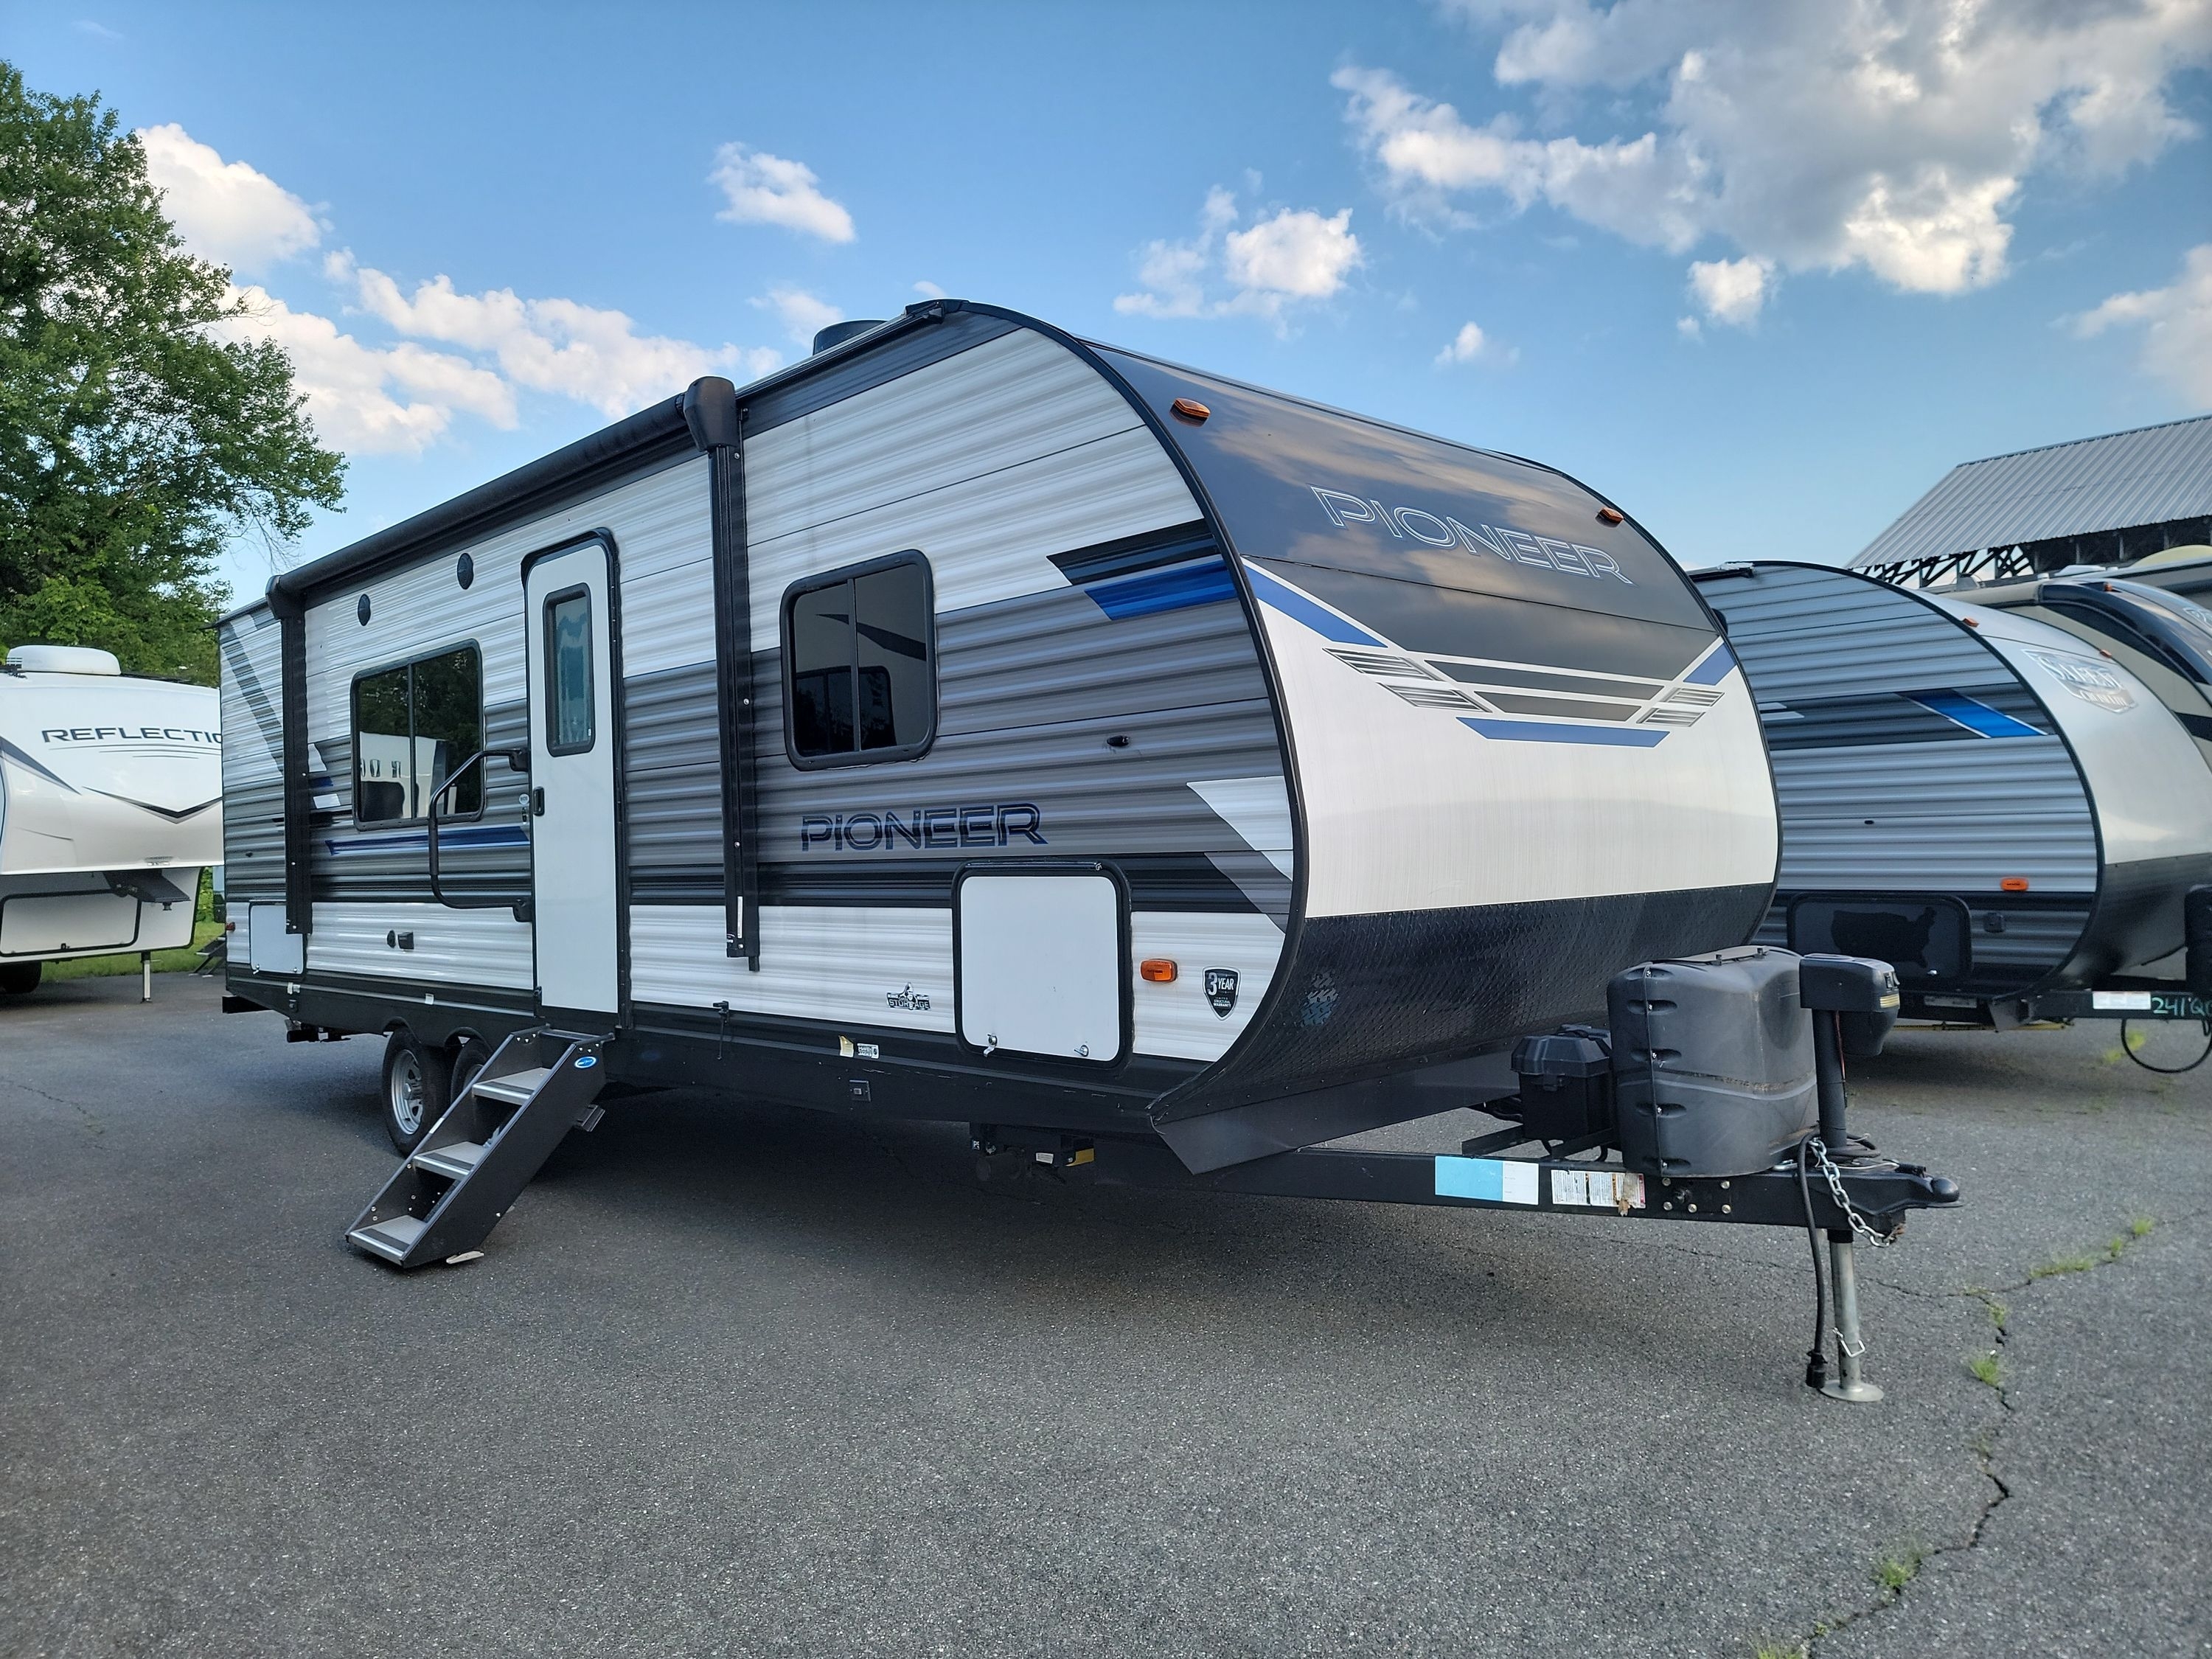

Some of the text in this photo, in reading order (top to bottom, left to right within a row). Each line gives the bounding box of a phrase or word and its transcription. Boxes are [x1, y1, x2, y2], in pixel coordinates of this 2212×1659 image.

[1310, 484, 1635, 585] PIONEER
[801, 802, 1049, 852] PIONEER
[1207, 972, 1234, 995] 3 YEAR
